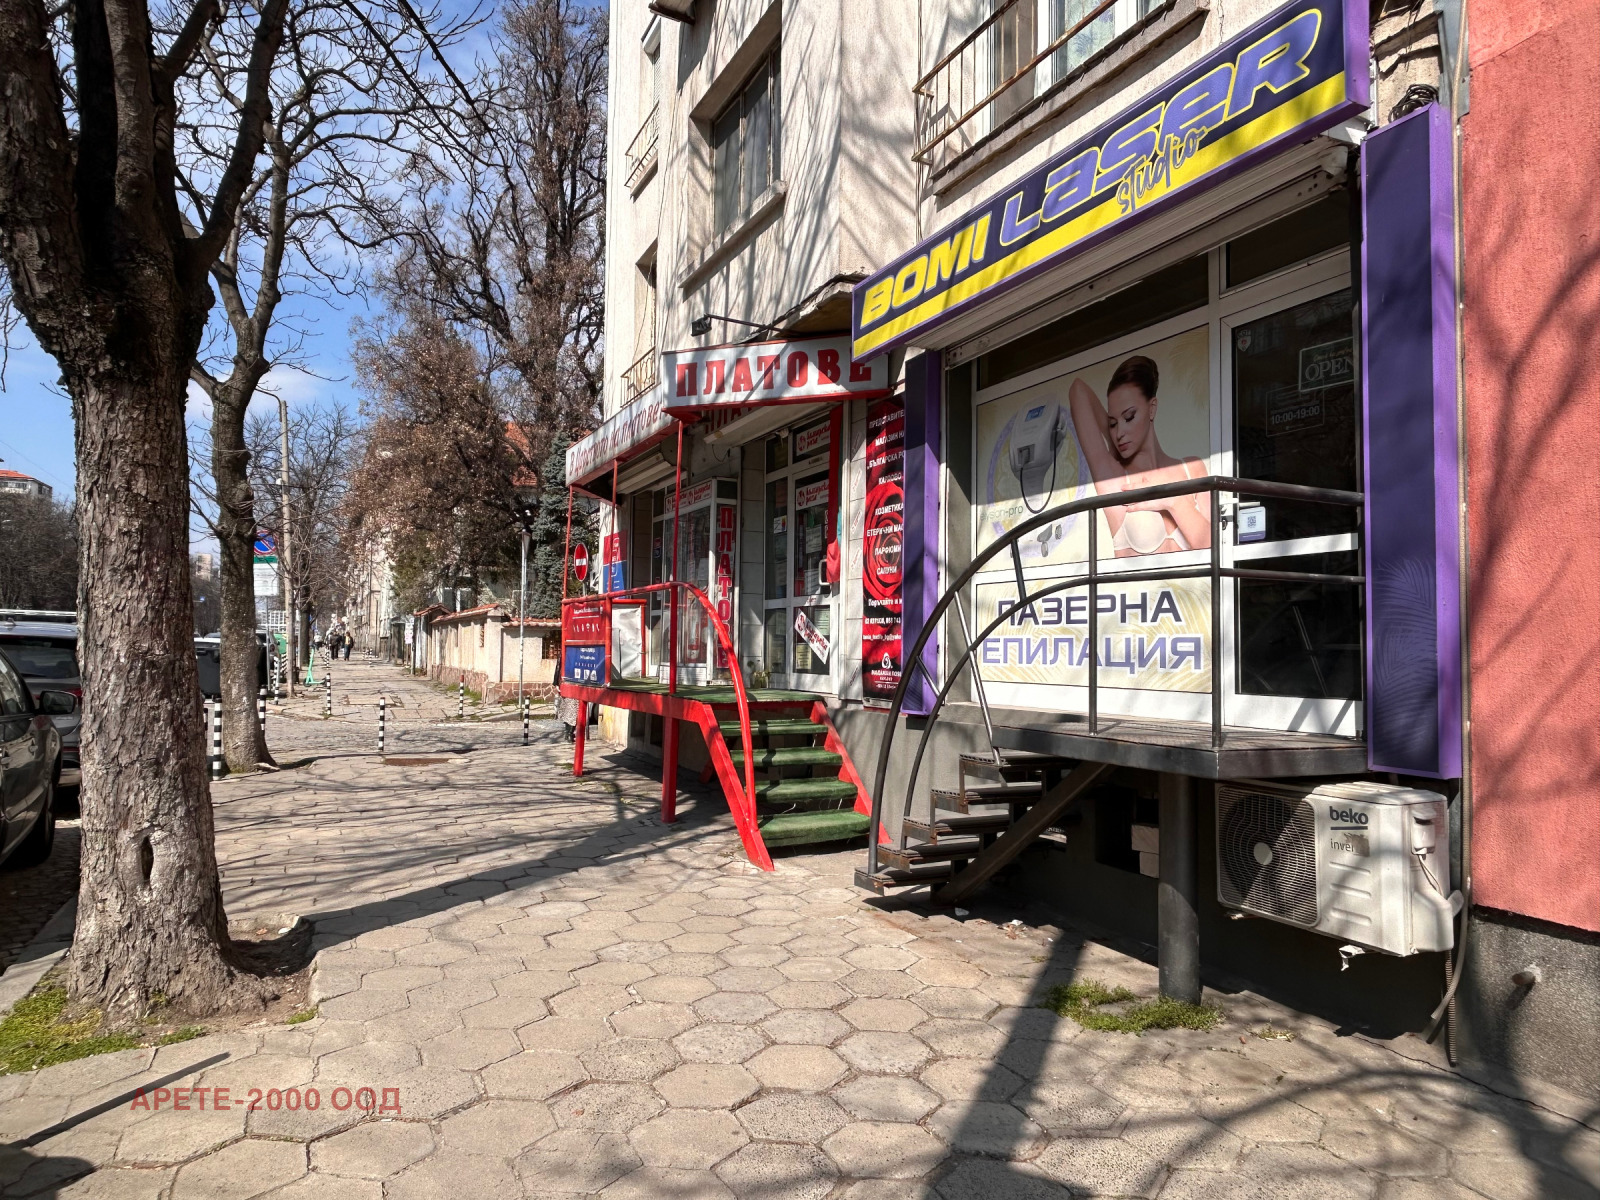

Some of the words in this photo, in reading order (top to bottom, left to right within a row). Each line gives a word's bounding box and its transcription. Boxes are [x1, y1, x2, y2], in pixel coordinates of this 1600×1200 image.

[1116, 126, 1208, 214] studio
[860, 211, 992, 329] BOMI
[875, 502, 904, 516] КОЗМЕТИКА
[998, 590, 1183, 626] ЛАЗЕРНА
[982, 637, 1202, 675] ЕПИЛАЦИЯ
[1329, 806, 1369, 825] beko
